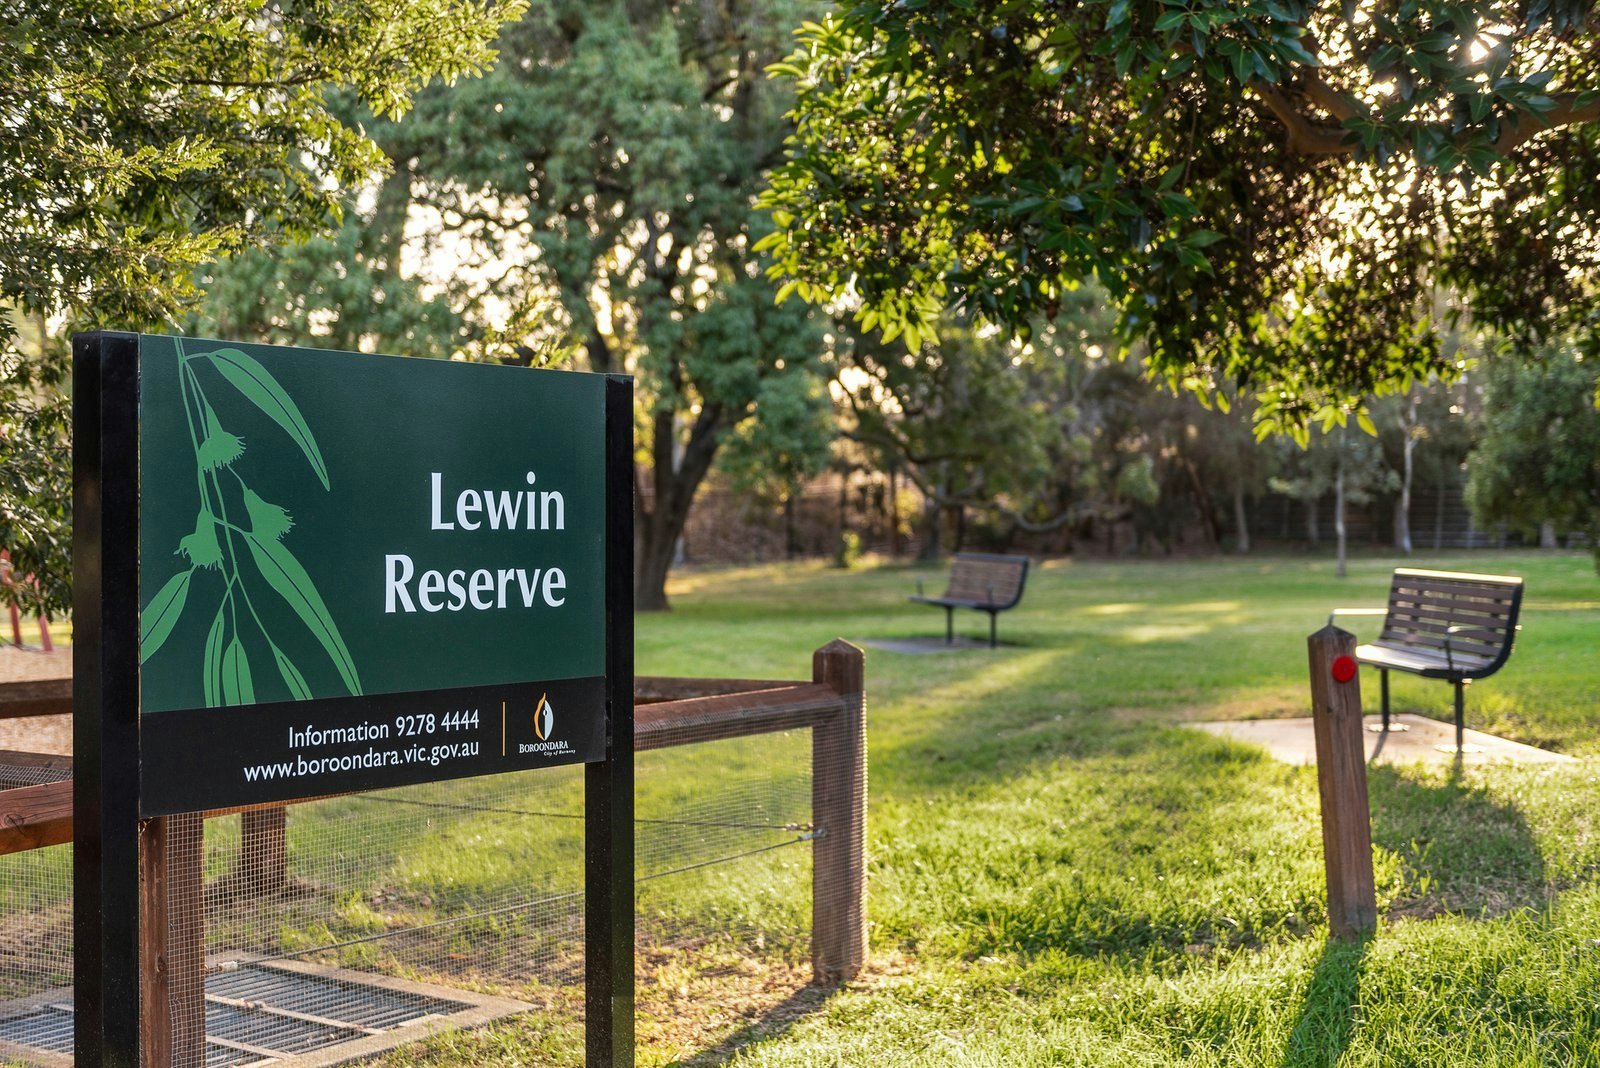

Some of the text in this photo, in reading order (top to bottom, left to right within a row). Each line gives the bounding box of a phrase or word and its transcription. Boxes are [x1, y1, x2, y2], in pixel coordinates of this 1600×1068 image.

[431, 471, 565, 530] Lewin
[385, 554, 567, 613] Reserve
[288, 709, 480, 748] Information 9278 4444
[518, 740, 569, 754] BOROONDARA
[243, 739, 480, 782] www.boroondara.vic.gov.au
